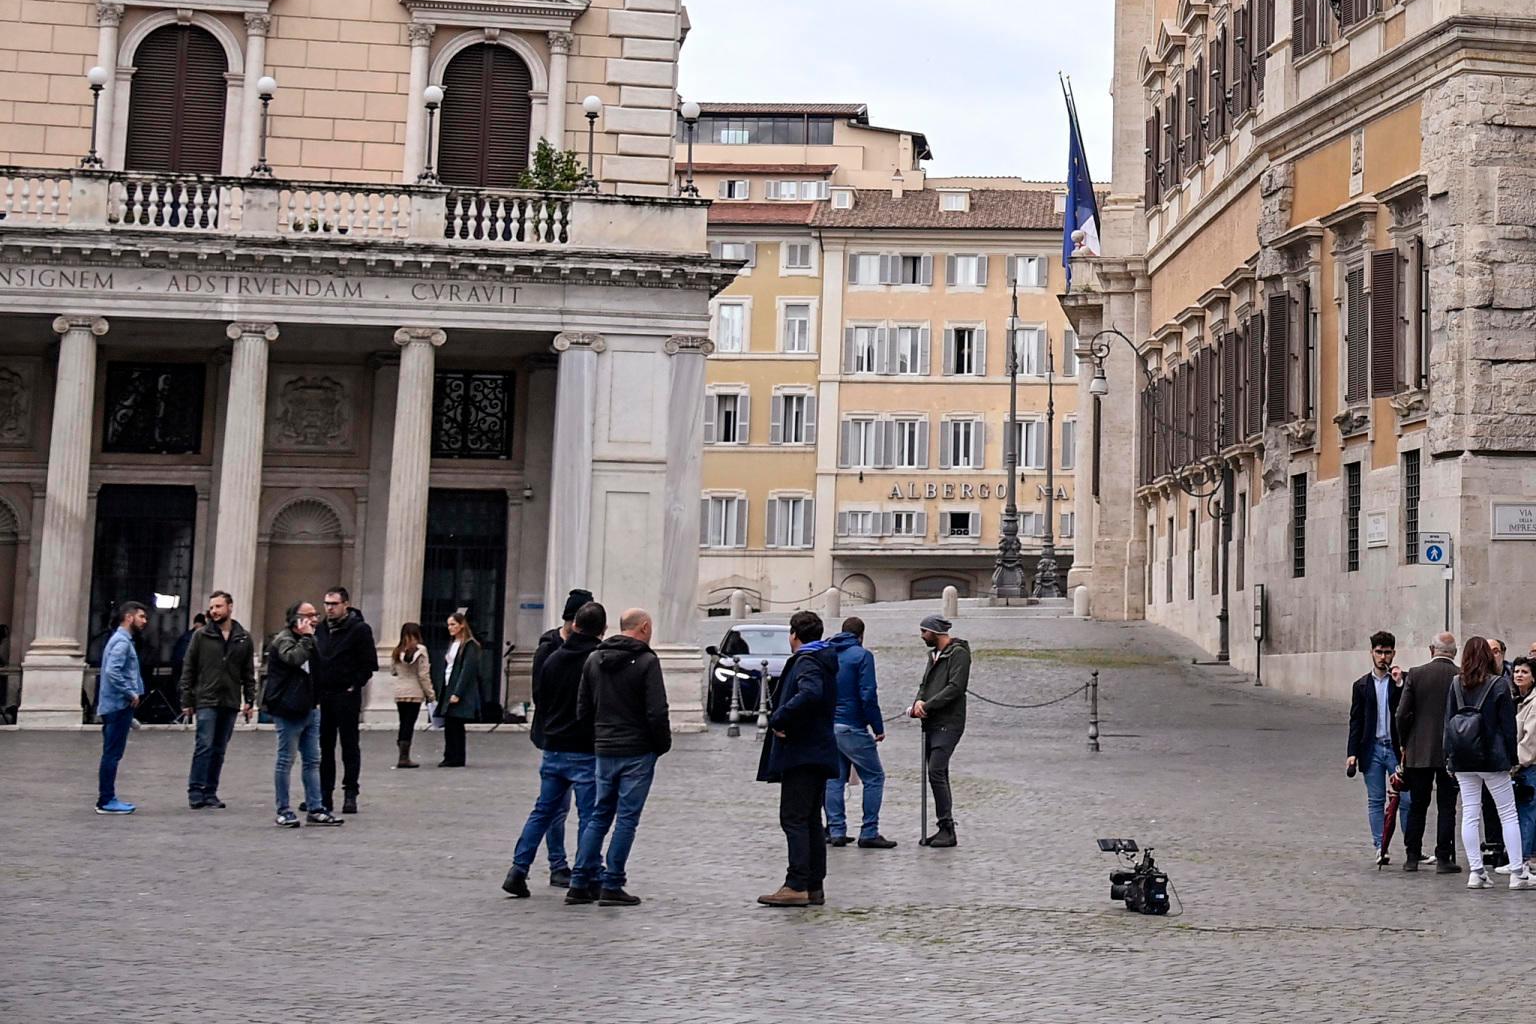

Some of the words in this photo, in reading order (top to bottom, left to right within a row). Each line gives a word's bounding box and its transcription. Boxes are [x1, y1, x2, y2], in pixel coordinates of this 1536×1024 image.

[0, 268, 113, 289] NSIGNEM
[166, 274, 364, 298] ADSTRVENDAM
[411, 283, 523, 303] CVRAVIT
[888, 483, 1008, 500] ALBERGO
[1036, 484, 1076, 500] NA
[1519, 509, 1533, 517] VIA
